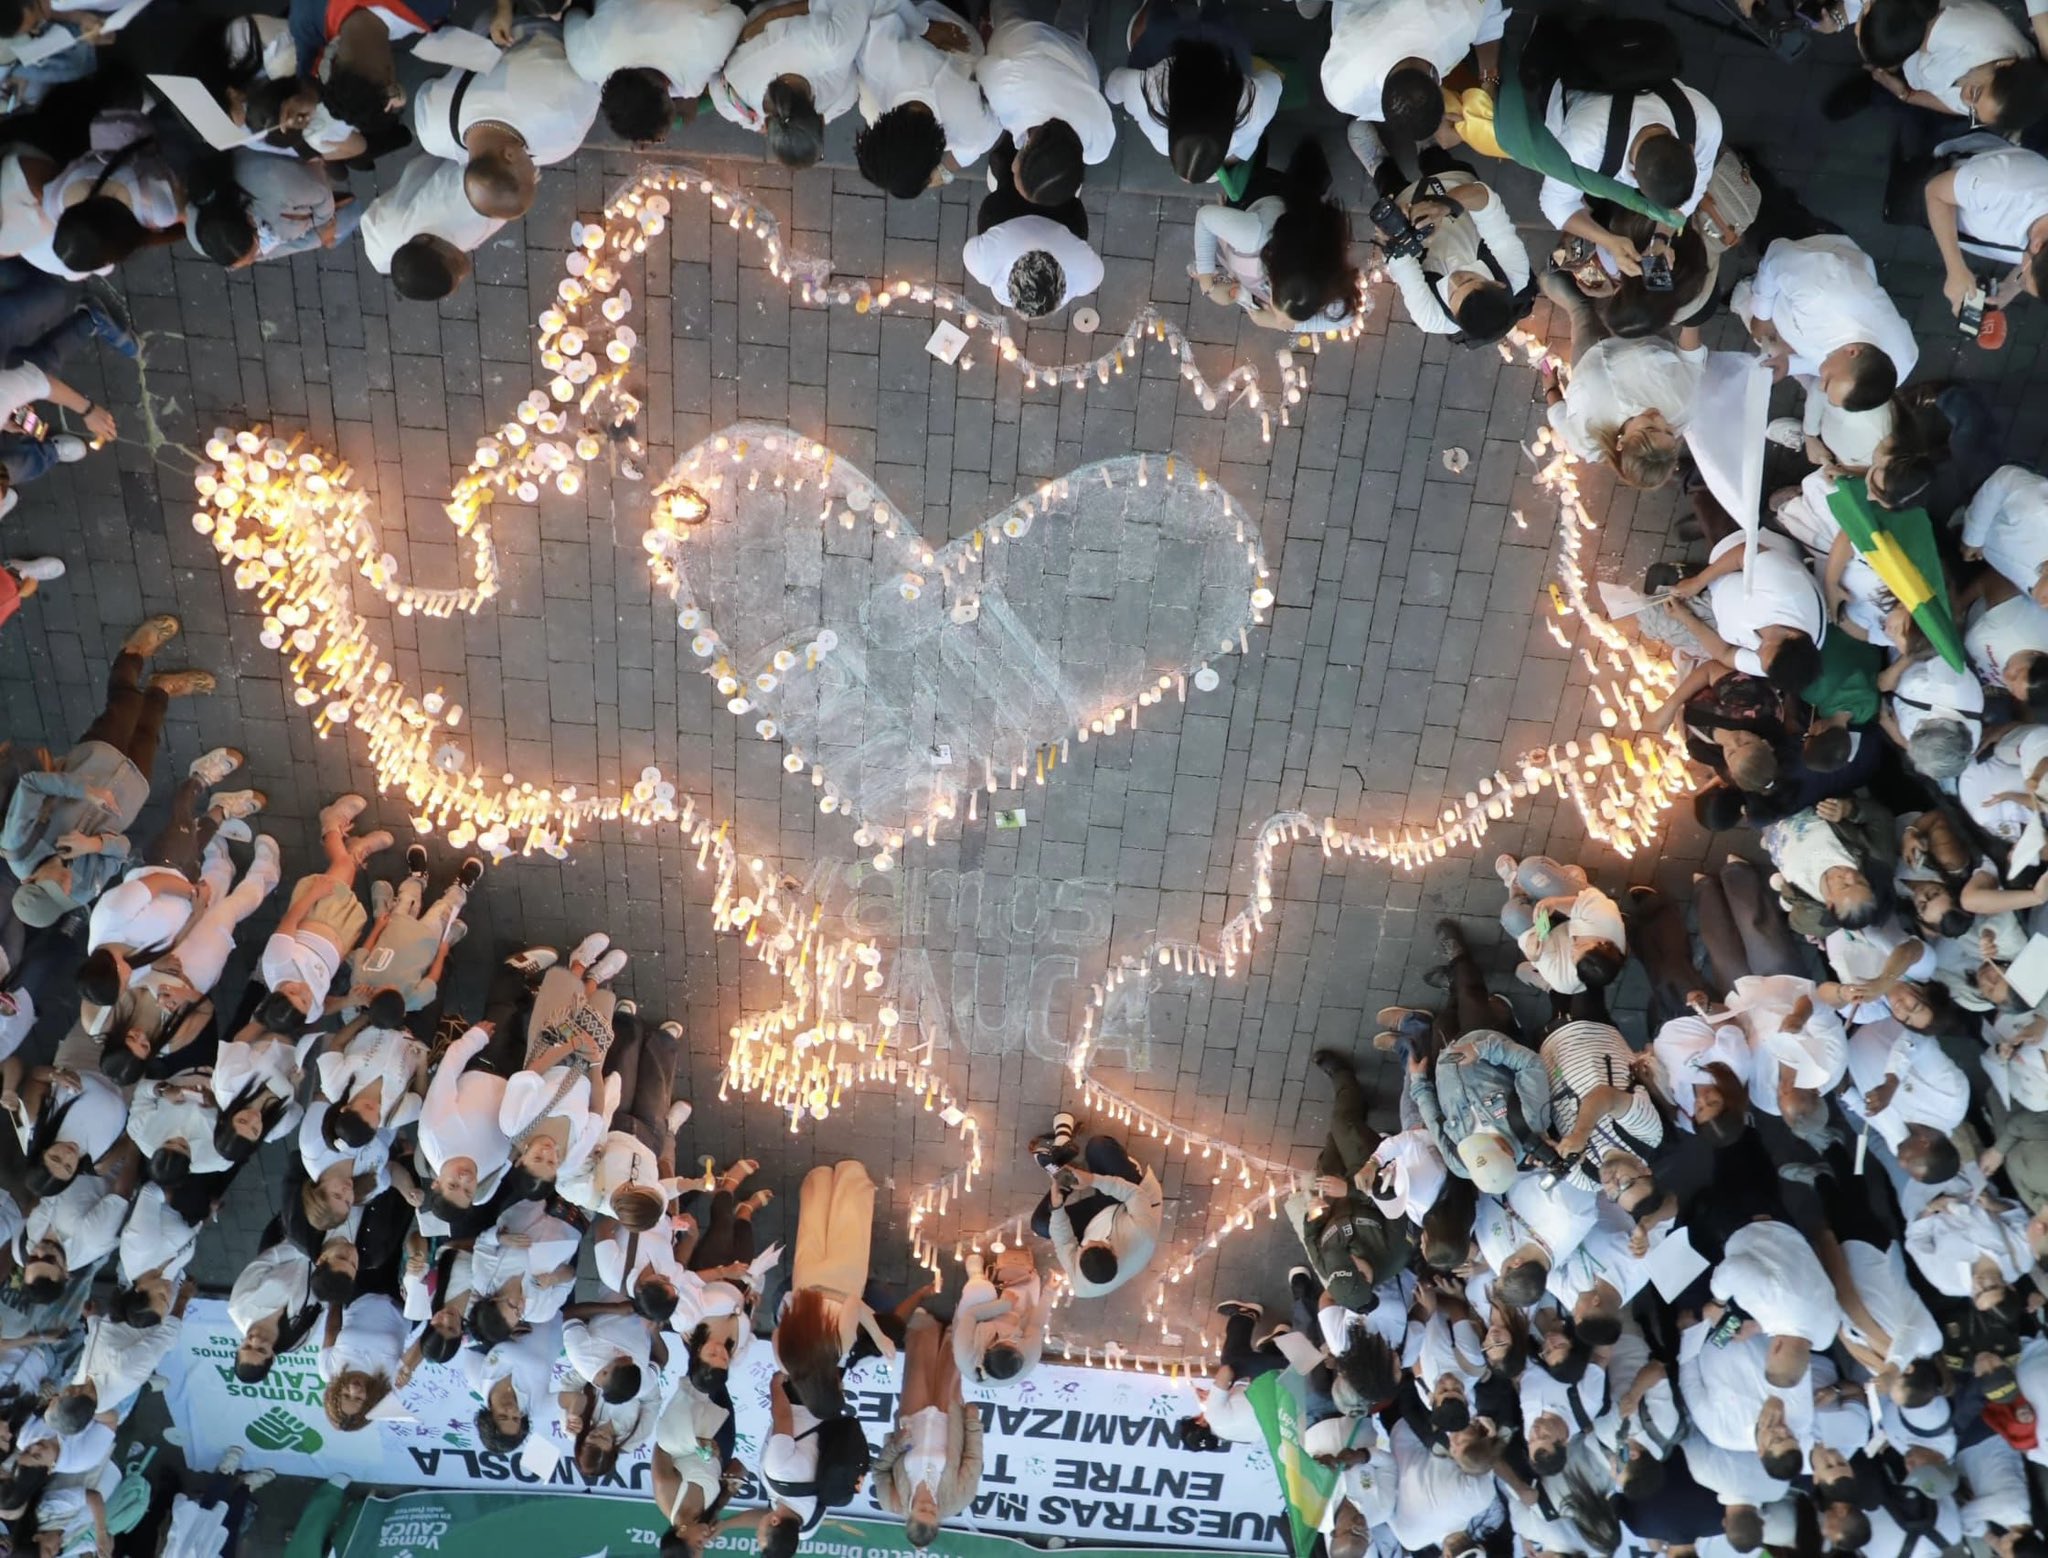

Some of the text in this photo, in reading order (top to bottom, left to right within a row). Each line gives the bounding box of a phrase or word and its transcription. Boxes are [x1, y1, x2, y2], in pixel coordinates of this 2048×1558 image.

[214, 1364, 326, 1391] CAUA
[226, 1384, 324, 1408] Vamos
[1052, 1458, 1225, 1502] ENTRE
[380, 1521, 448, 1537] CAUCA
[378, 1535, 440, 1550] Vamos
